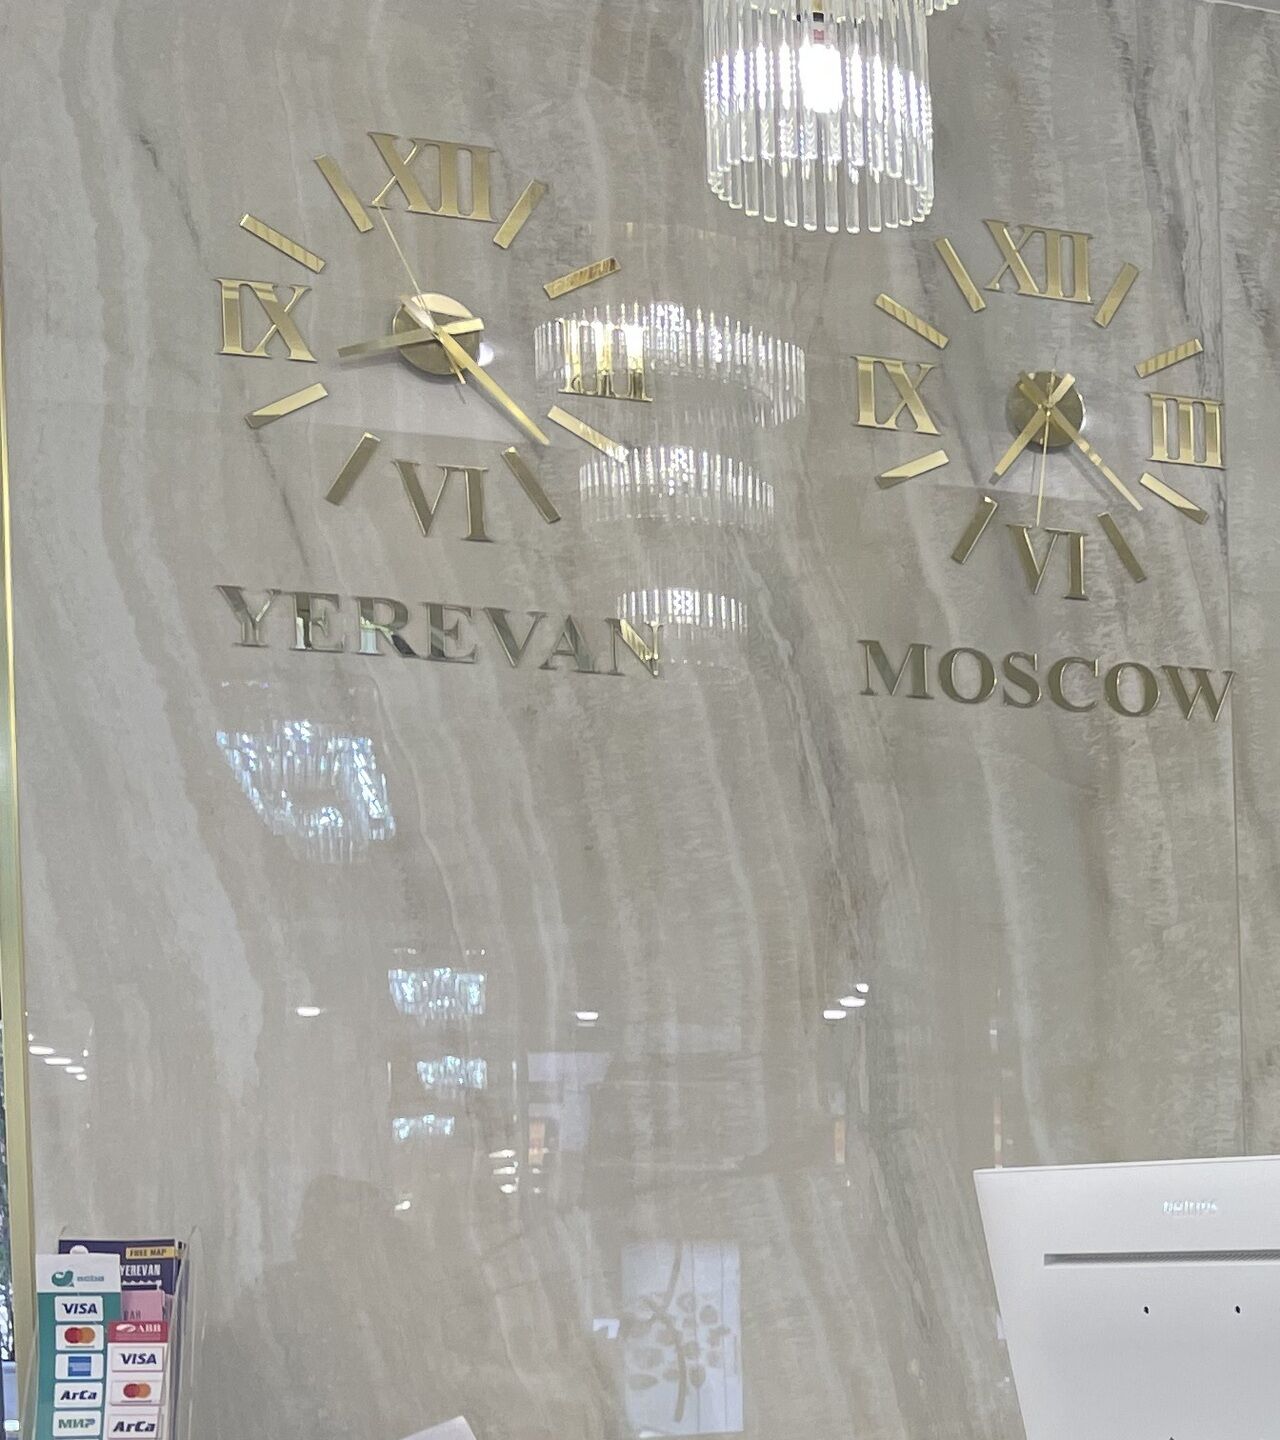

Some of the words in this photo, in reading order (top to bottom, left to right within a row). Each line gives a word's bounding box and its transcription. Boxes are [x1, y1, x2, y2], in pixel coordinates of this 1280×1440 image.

[367, 131, 498, 222] XII
[983, 218, 1093, 303] XII
[215, 277, 318, 363] IX
[853, 354, 941, 435] IX
[1149, 392, 1226, 470] III
[392, 457, 494, 543] VI
[1006, 523, 1089, 600] VI
[215, 584, 666, 678] YEREVAN
[857, 639, 1236, 726] MOSCOW
[120, 1264, 161, 1277] YEREVAN
[129, 1249, 148, 1257] FREE
[150, 1248, 166, 1256] MAP
[62, 1303, 98, 1315] VISA
[60, 1390, 98, 1401] ArCa
[120, 1353, 157, 1365] VISA
[113, 1421, 156, 1433] ArCa
